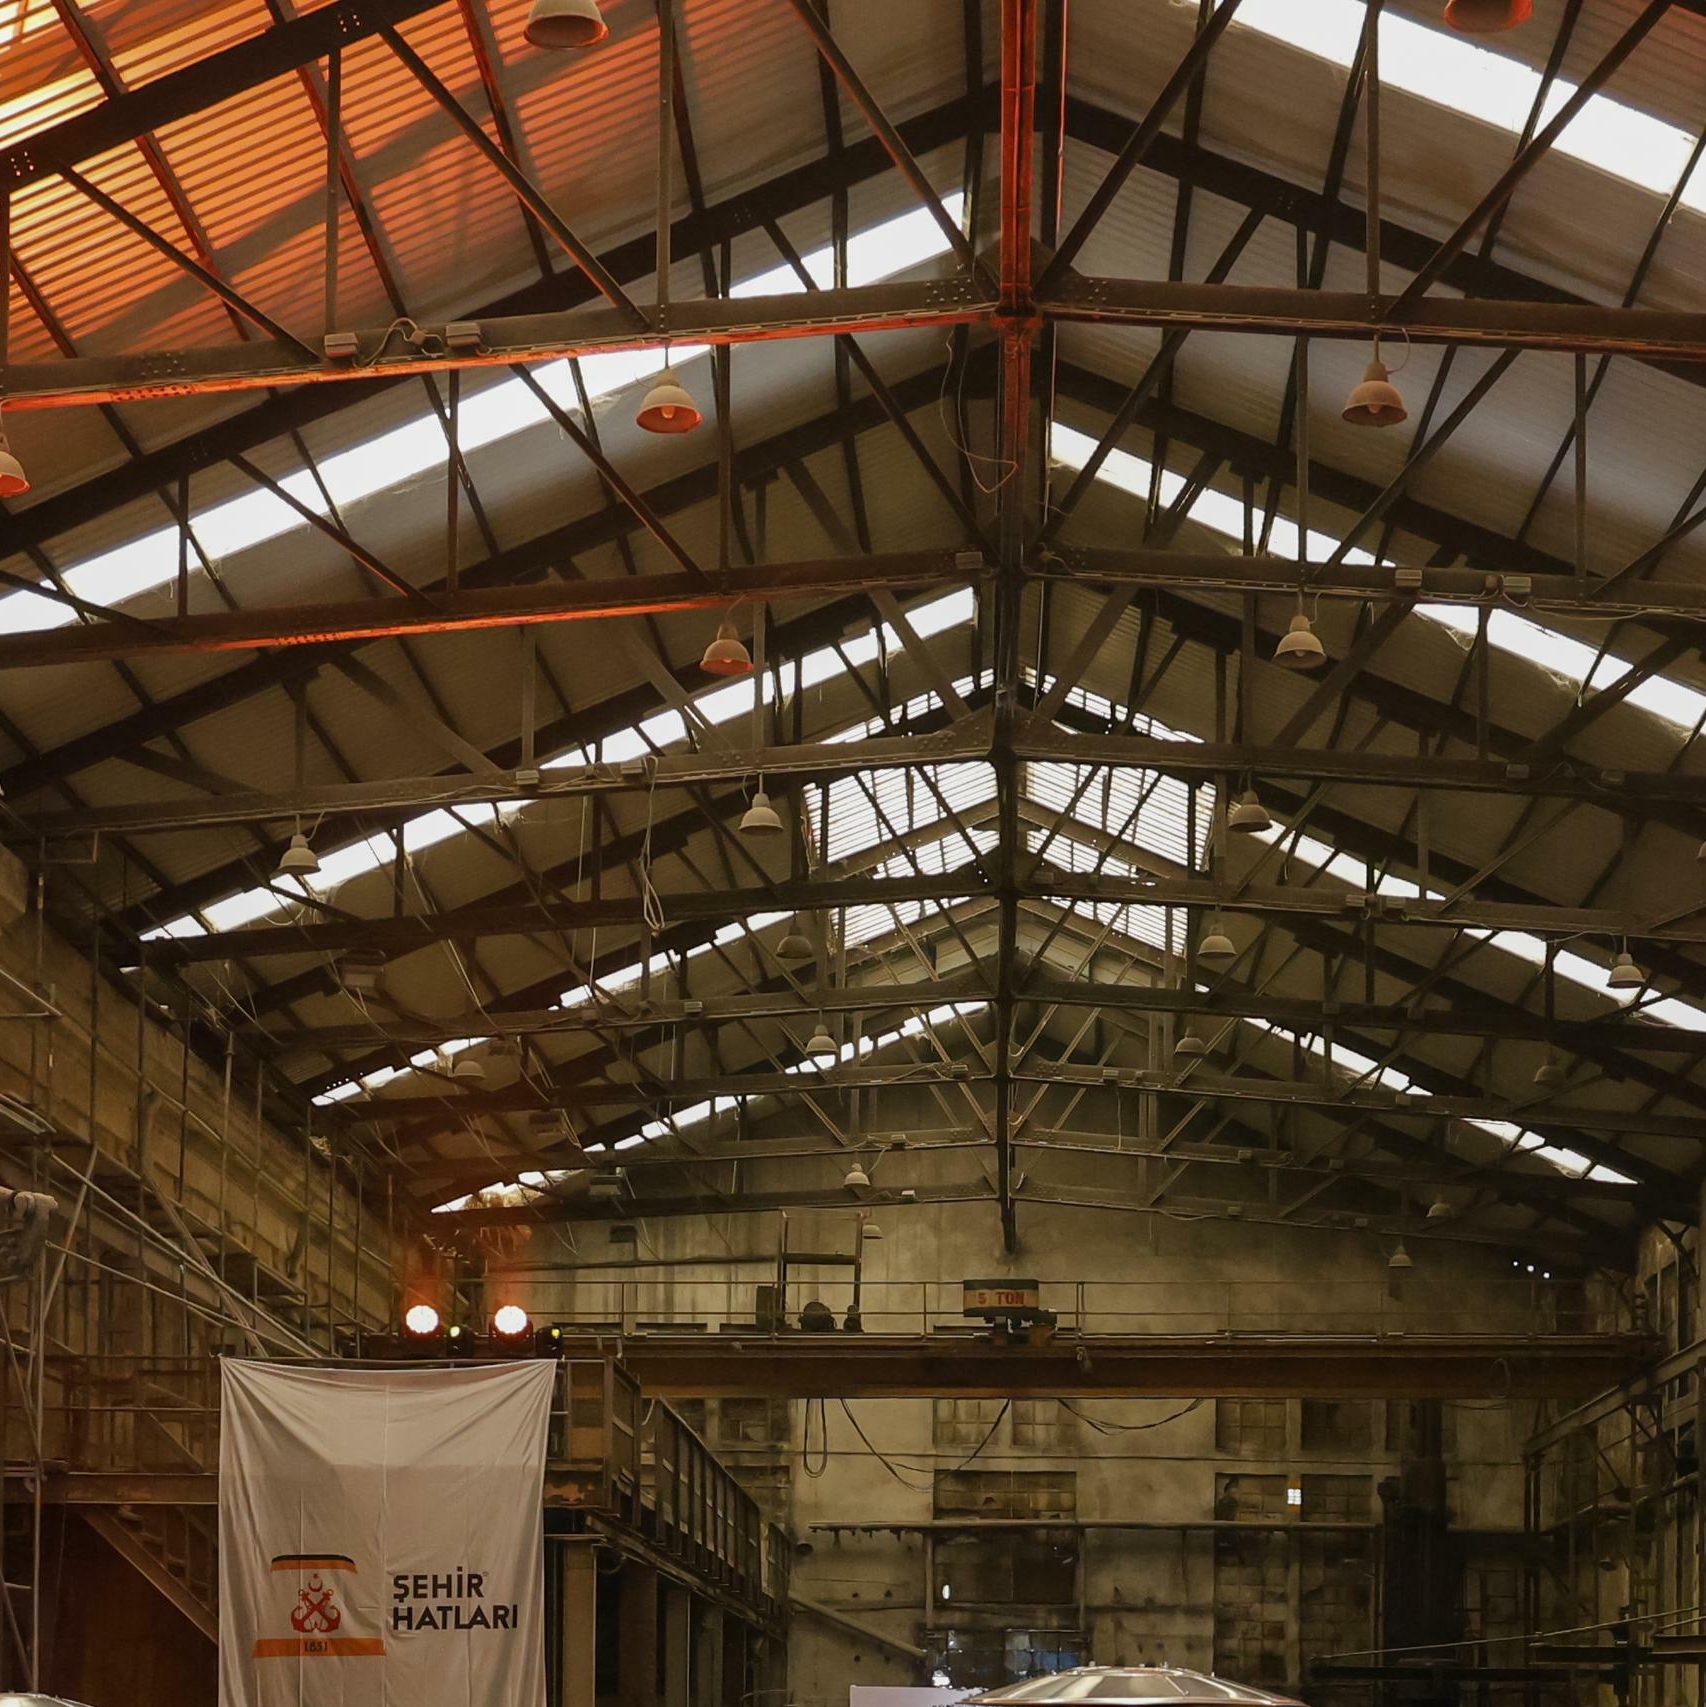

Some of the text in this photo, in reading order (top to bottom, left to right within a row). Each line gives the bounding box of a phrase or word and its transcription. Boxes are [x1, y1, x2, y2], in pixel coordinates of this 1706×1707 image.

[977, 1291, 1025, 1305] 5 TON
[393, 1566, 484, 1602] ŞEHİR
[393, 1604, 518, 1630] HATLARI
[303, 1640, 328, 1653] 1851
